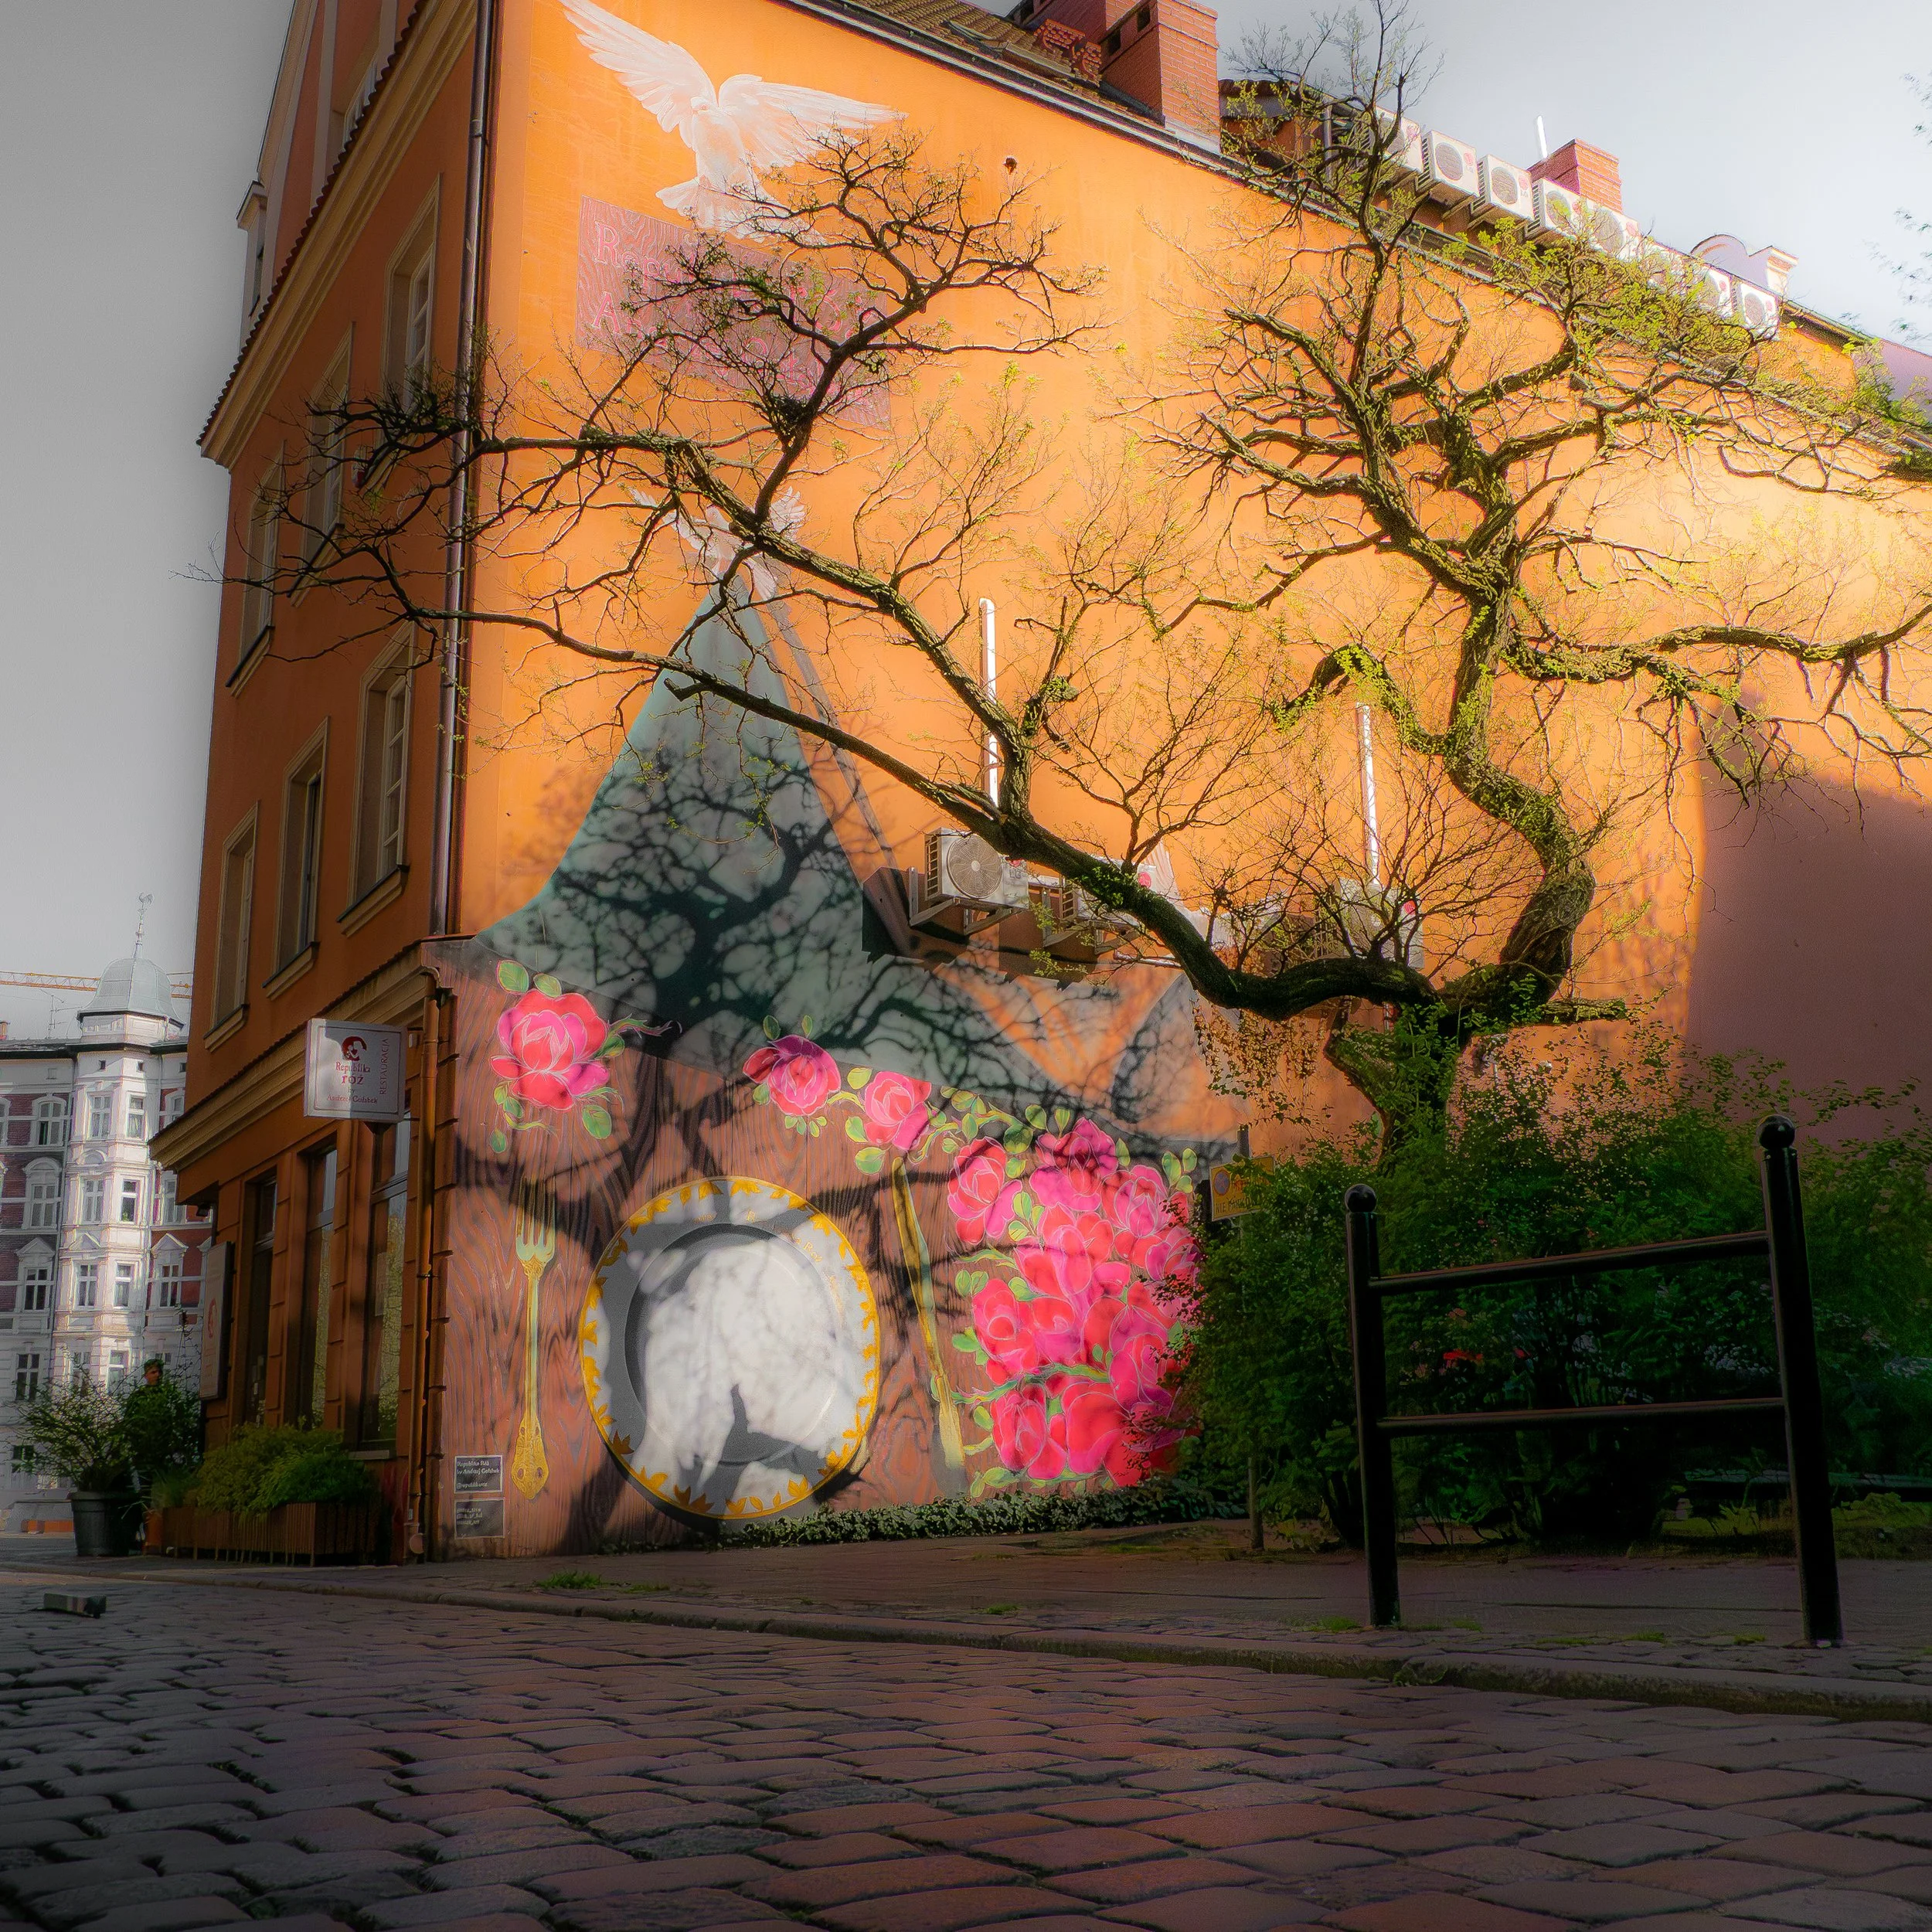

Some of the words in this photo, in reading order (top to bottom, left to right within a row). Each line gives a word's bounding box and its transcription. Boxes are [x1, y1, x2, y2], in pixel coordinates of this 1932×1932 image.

[335, 1061, 371, 1074] Republika
[379, 1038, 389, 1095] RESTAURACJA
[1216, 1202, 1226, 1213] NIE
